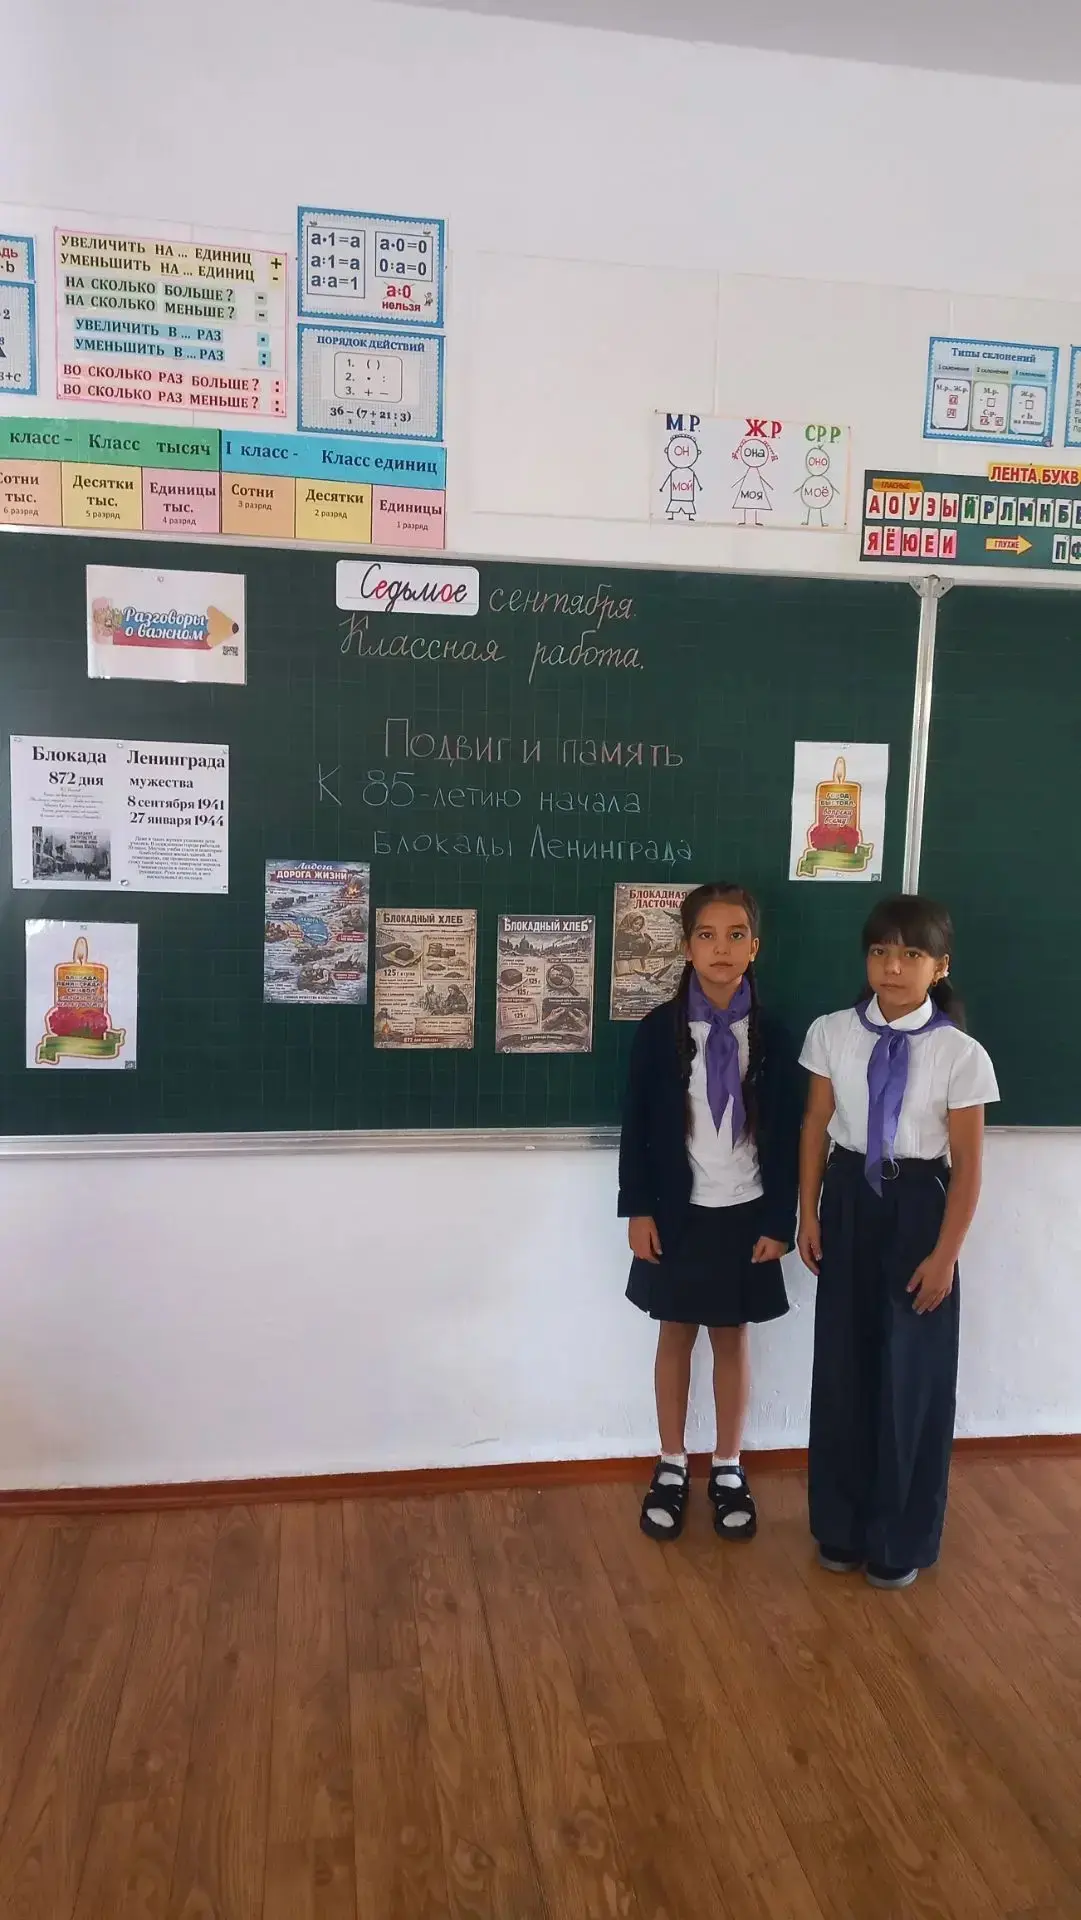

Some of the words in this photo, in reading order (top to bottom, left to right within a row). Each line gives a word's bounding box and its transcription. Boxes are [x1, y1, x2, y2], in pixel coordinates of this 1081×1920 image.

[0, 248, 18, 259] ДЬ
[61, 235, 146, 254] УВЕЛИЧИТЬ
[195, 248, 252, 265] ЕДИНИЦ
[61, 253, 151, 272] УМЕНЬШИТЬ
[198, 266, 255, 283] ЕДИНИЦ
[65, 276, 85, 289] НА
[91, 278, 156, 295] СКОЛЬКО
[65, 294, 85, 307] НА
[90, 295, 156, 312] СКОЛЬКО
[382, 300, 421, 312] нельзя
[75, 319, 159, 336] УВЕЛИЧИТЬ
[197, 328, 222, 342] РАЗ
[75, 339, 165, 356] УМЕНЬШИТЬ
[200, 348, 224, 361] РАЗ
[317, 336, 368, 347] ПОРЯДОК
[369, 339, 425, 352] ДЕЙСТВИЙ
[951, 348, 980, 359] Типы
[982, 351, 1036, 363] склонений
[63, 364, 81, 376] ВО
[88, 365, 152, 381] СКОЛЬКО
[158, 371, 183, 384] РАЗ
[63, 384, 81, 396] ВО
[87, 386, 152, 401] СКОЛЬКО
[158, 391, 183, 404] РАЗ
[330, 406, 344, 417] 36
[10, 431, 60, 445] класс
[88, 433, 141, 451] Класс
[156, 440, 211, 456] тысяч
[241, 445, 289, 460] класс
[321, 450, 370, 468] Класс
[374, 459, 438, 475] единиц
[72, 475, 134, 490] Десятки
[990, 466, 1038, 482] ЛЕНТА
[1042, 469, 1079, 485] БУКВ
[5, 492, 37, 503] тыс.
[150, 482, 217, 498] Единицы
[231, 483, 274, 499] Сотни
[305, 488, 364, 504] Десятки
[87, 496, 118, 507] тыс.
[163, 502, 194, 513] тыс.
[238, 500, 243, 508] 3
[245, 502, 272, 511] разряд
[379, 500, 442, 516] Единицы
[10, 508, 39, 517] разряд
[86, 510, 91, 518] 5
[92, 511, 121, 520] разряд
[314, 509, 320, 517] 2
[321, 510, 348, 519] разряд
[162, 516, 168, 524] 4
[169, 517, 196, 526] разряд
[397, 521, 401, 529] 1
[402, 522, 429, 531] разряд
[360, 563, 467, 612] Седьмое
[123, 606, 206, 632] Разговоры
[125, 627, 132, 636] о
[138, 623, 203, 641] важном
[339, 612, 506, 662] Классная
[528, 630, 645, 684] работа.
[385, 718, 511, 767] Подвиг
[523, 739, 540, 763] и
[563, 738, 684, 767] память
[32, 746, 107, 765] Блокада
[126, 750, 225, 770] Ленинграда
[49, 771, 76, 786] 872
[78, 776, 104, 787] дня
[129, 776, 194, 790] мужества
[362, 769, 521, 807] 85-летию
[540, 791, 641, 814] начала
[127, 795, 136, 807] 8
[138, 797, 195, 810] сентября
[197, 798, 225, 811] 1941
[129, 812, 146, 824] 27
[147, 816, 192, 827] января
[194, 815, 225, 827] 1944
[373, 831, 512, 861] Блокады
[530, 824, 693, 867] Ленинграда
[276, 871, 312, 879] ДОРОГА
[314, 871, 347, 880] ЖИЗНИ
[629, 890, 688, 899] БЛОКАДНАЯ
[383, 913, 435, 924] БЛОКАДНЫЙ
[438, 915, 463, 924] ХЛЕБ
[504, 919, 560, 932] БЛОКАДНЫЙ
[563, 920, 589, 931] ХЛЕБ
